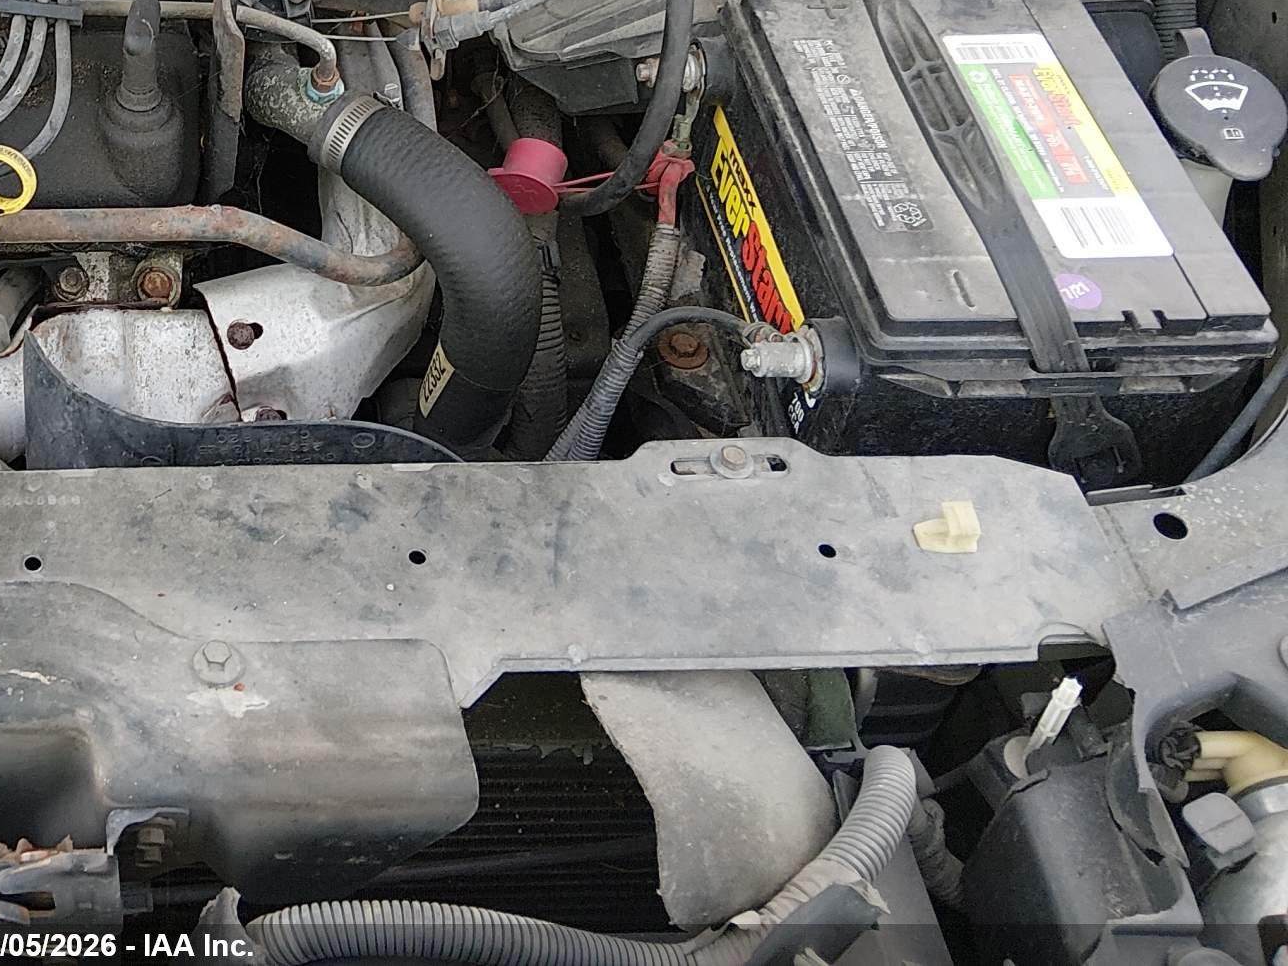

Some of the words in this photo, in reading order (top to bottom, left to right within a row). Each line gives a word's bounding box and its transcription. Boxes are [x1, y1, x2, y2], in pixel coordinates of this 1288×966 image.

[854, 96, 888, 149] DANGER/POISON
[729, 148, 756, 208] maxx
[422, 351, 447, 403] 22332
[792, 392, 805, 423] 700
